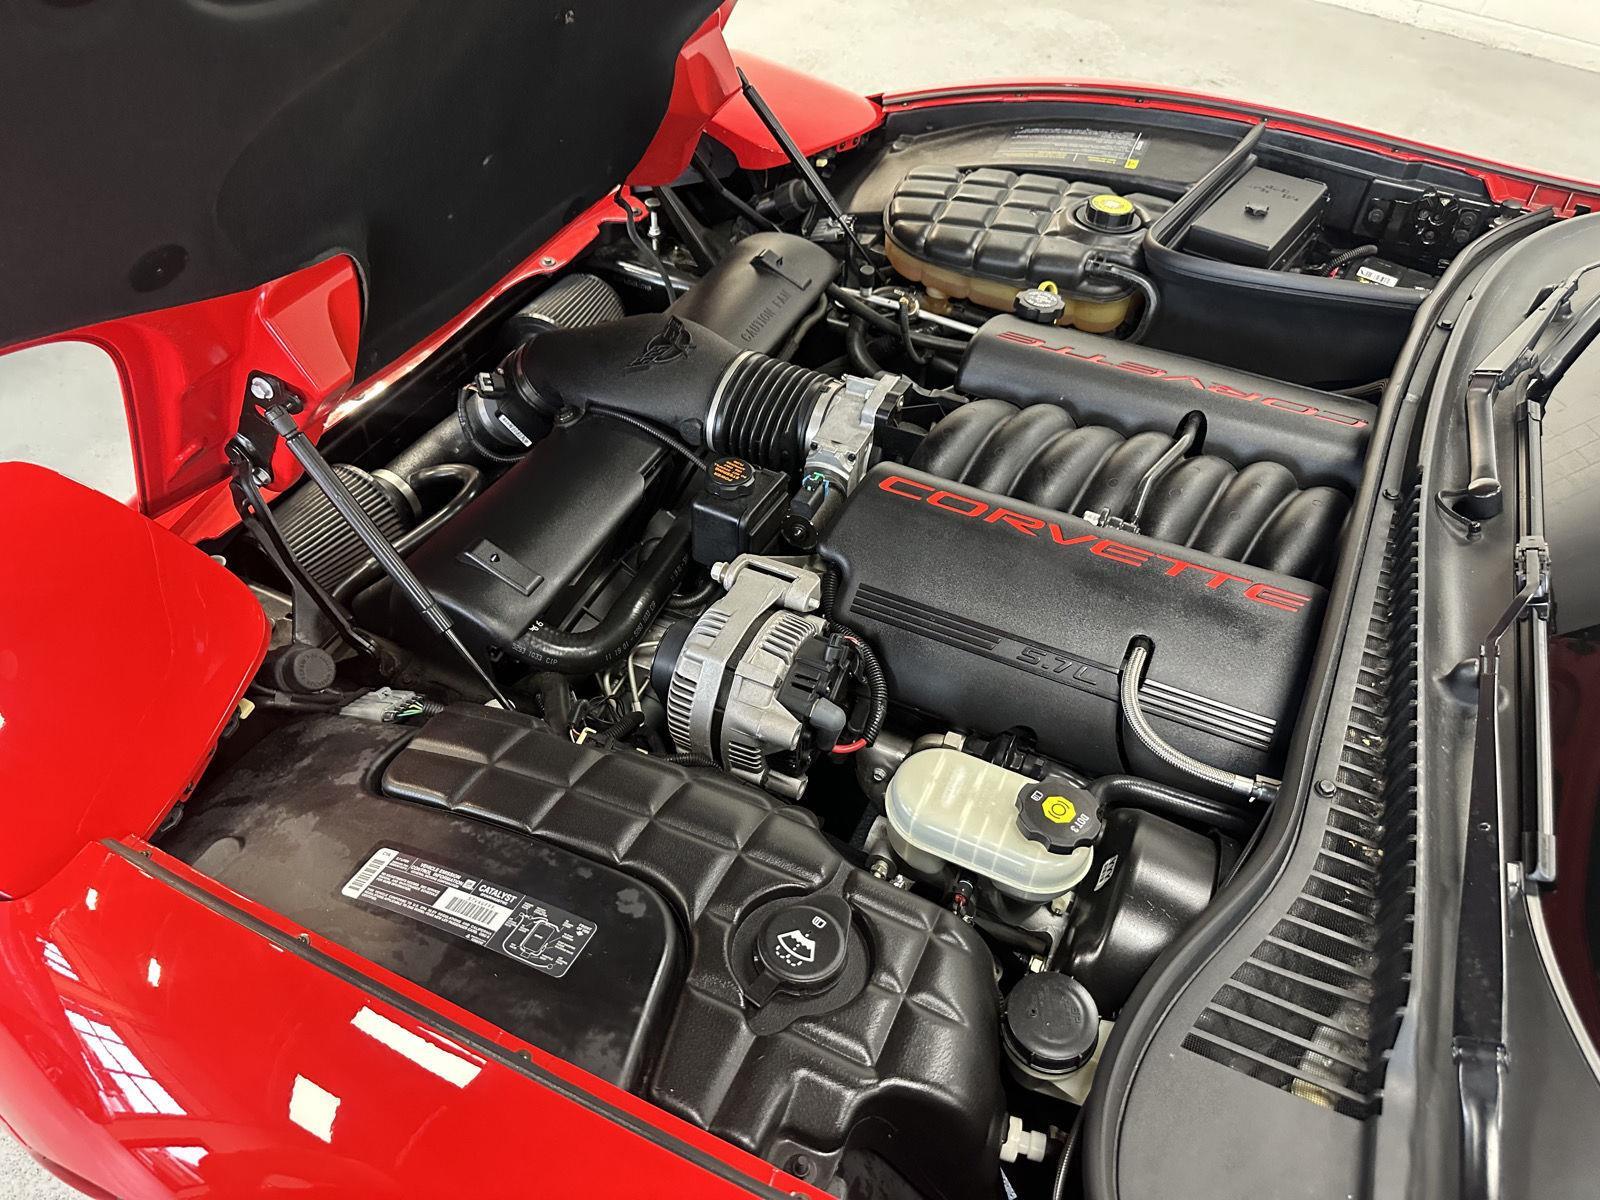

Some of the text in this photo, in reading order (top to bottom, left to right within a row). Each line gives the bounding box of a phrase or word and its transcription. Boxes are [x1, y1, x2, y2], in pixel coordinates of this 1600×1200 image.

[740, 289, 791, 343] CAUTION FAN
[996, 331, 1368, 428] CORVETTE
[878, 475, 1310, 612] CORVETTE
[1016, 646, 1096, 684] 5.7L
[1076, 813, 1090, 828] DOT
[477, 884, 518, 904] CATALYST
